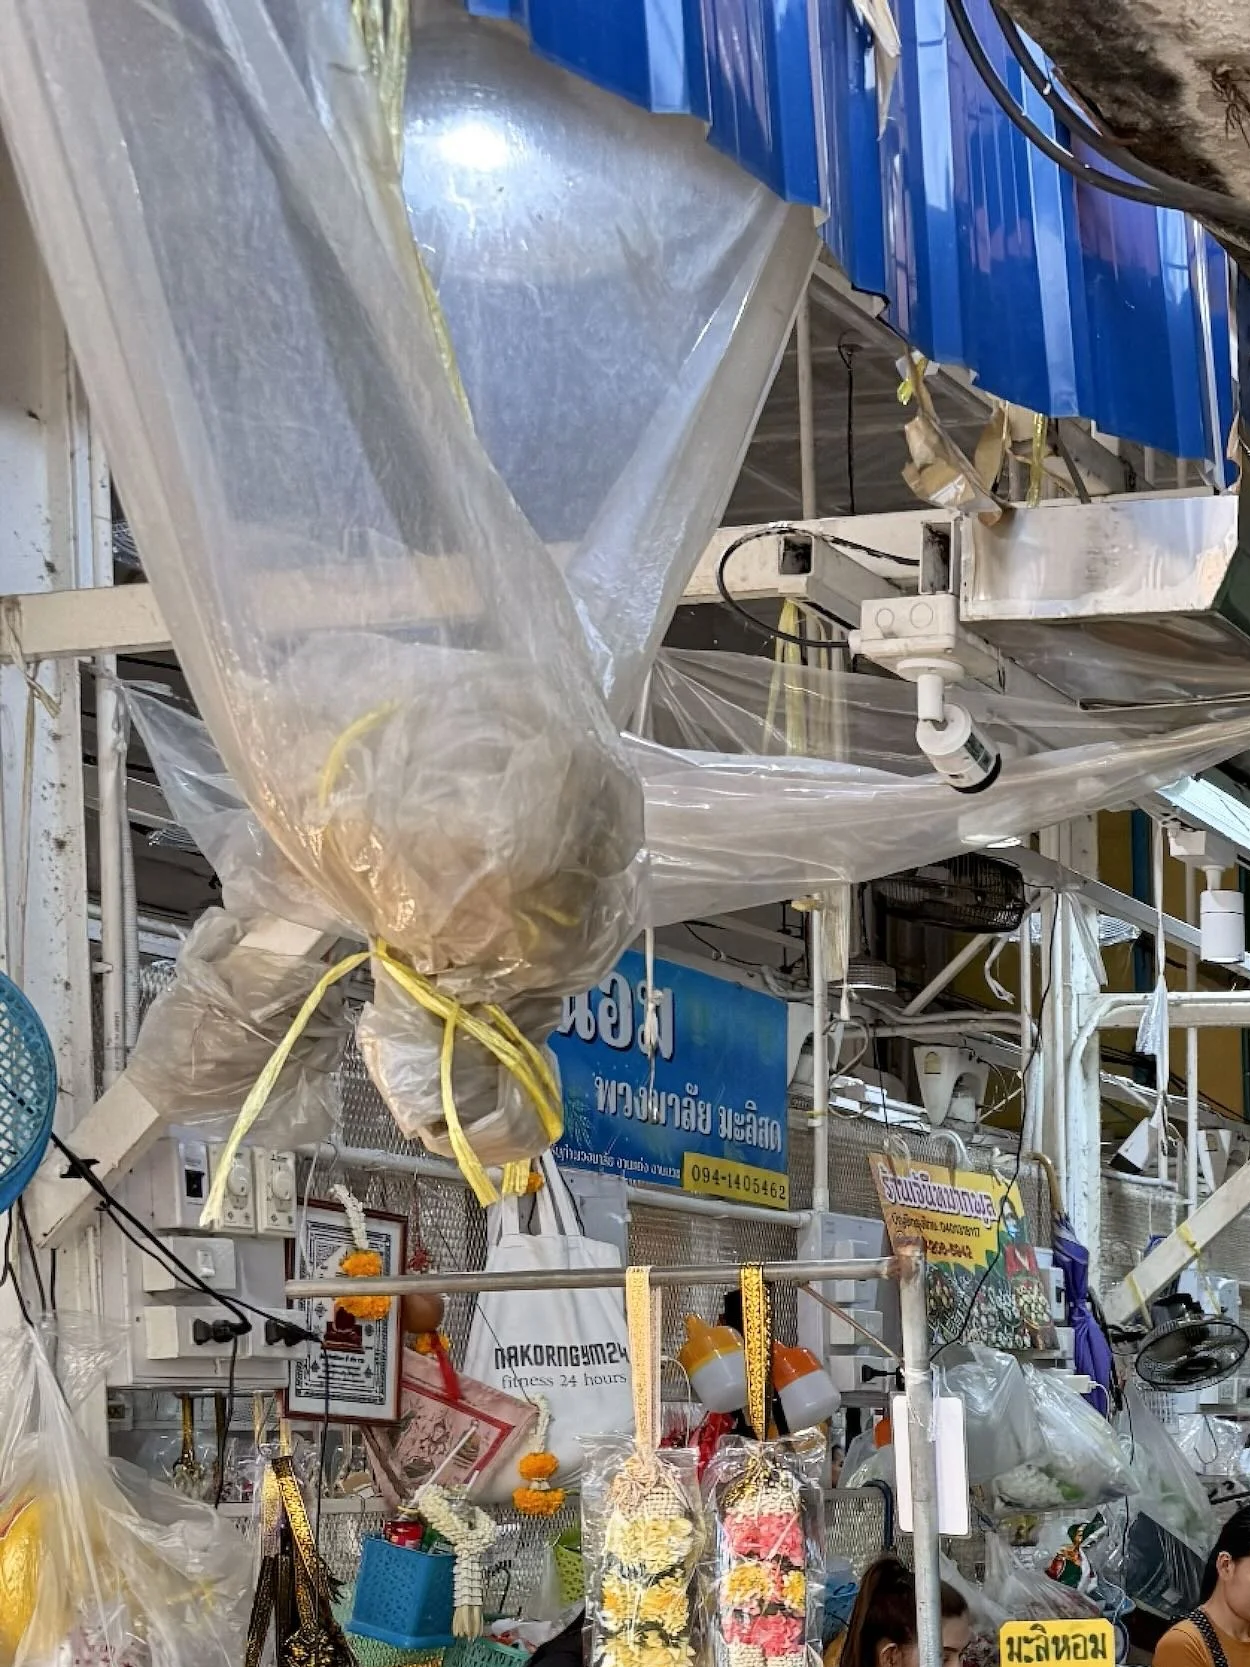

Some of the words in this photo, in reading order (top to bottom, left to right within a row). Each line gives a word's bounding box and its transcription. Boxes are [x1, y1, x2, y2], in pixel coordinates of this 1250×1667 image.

[594, 1076, 711, 1136] พวงมาลัย
[718, 1100, 783, 1153] มะลิสด
[691, 1164, 787, 1200] 094-1405462
[502, 1373, 554, 1390] fitness
[559, 1374, 578, 1388] 24
[584, 1372, 627, 1387] hours
[1005, 1623, 1108, 1663] มะลิหอม
